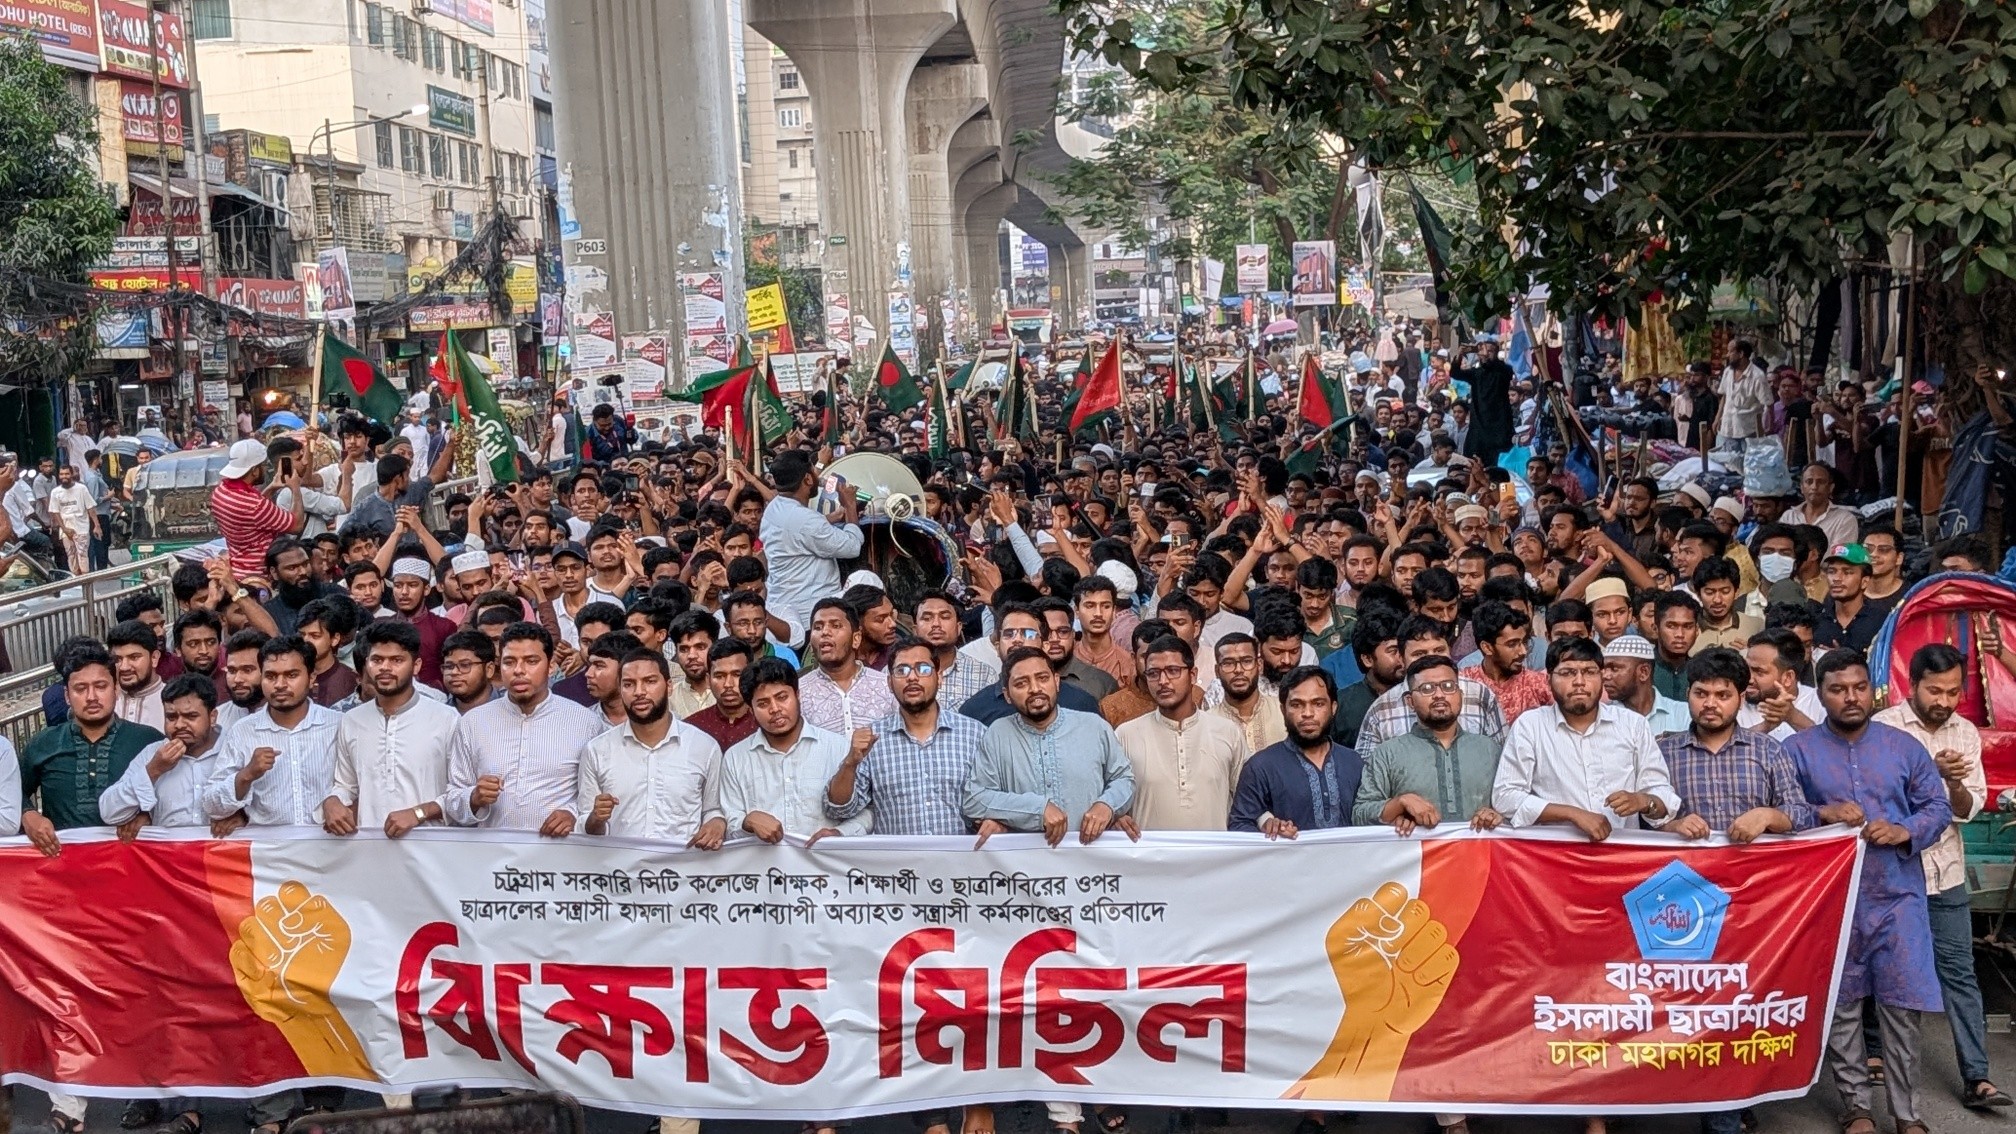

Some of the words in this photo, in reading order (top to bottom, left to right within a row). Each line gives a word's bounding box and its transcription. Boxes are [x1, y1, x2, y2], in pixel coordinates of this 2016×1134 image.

[28, 10, 69, 32] HOTEL
[69, 22, 92, 38] (RES.)
[576, 242, 606, 253] P603
[121, 276, 158, 290] হোটেল
[493, 864, 557, 894] চট্টগ্রাম
[561, 869, 632, 894] সরকারি
[637, 869, 680, 893] সিটি
[689, 873, 761, 894] কলেজে
[847, 869, 920, 896] শিক্ষার্থী
[927, 877, 944, 895] ও
[951, 871, 1067, 897] ছাত্রশিবিরের
[1074, 873, 1122, 895] ওপর
[459, 898, 549, 921] ছাত্রদলের
[554, 894, 613, 922] সন্ত্রাসী
[619, 902, 673, 922] হামলা
[680, 902, 720, 924] এবং
[727, 897, 816, 925] দেশব্যাপী
[824, 903, 905, 925] অব্যাহত
[911, 898, 971, 925] সন্ত্রাসী
[976, 898, 1075, 925] কর্মকাণ্ডের
[1079, 897, 1167, 925] প্রতিবাদে
[1605, 962, 1749, 992] বাংলাদেশ
[395, 921, 830, 1086] বিক্ষোভ
[878, 927, 1248, 1086] মিছিল
[1533, 992, 1655, 1033] ইসলামী
[1664, 990, 1809, 1036] ছাত্রশিবির
[1547, 1038, 1610, 1069] ঢাকা
[1618, 1039, 1724, 1070] মহানগর
[1730, 1029, 1798, 1064] দক্ষিণ
